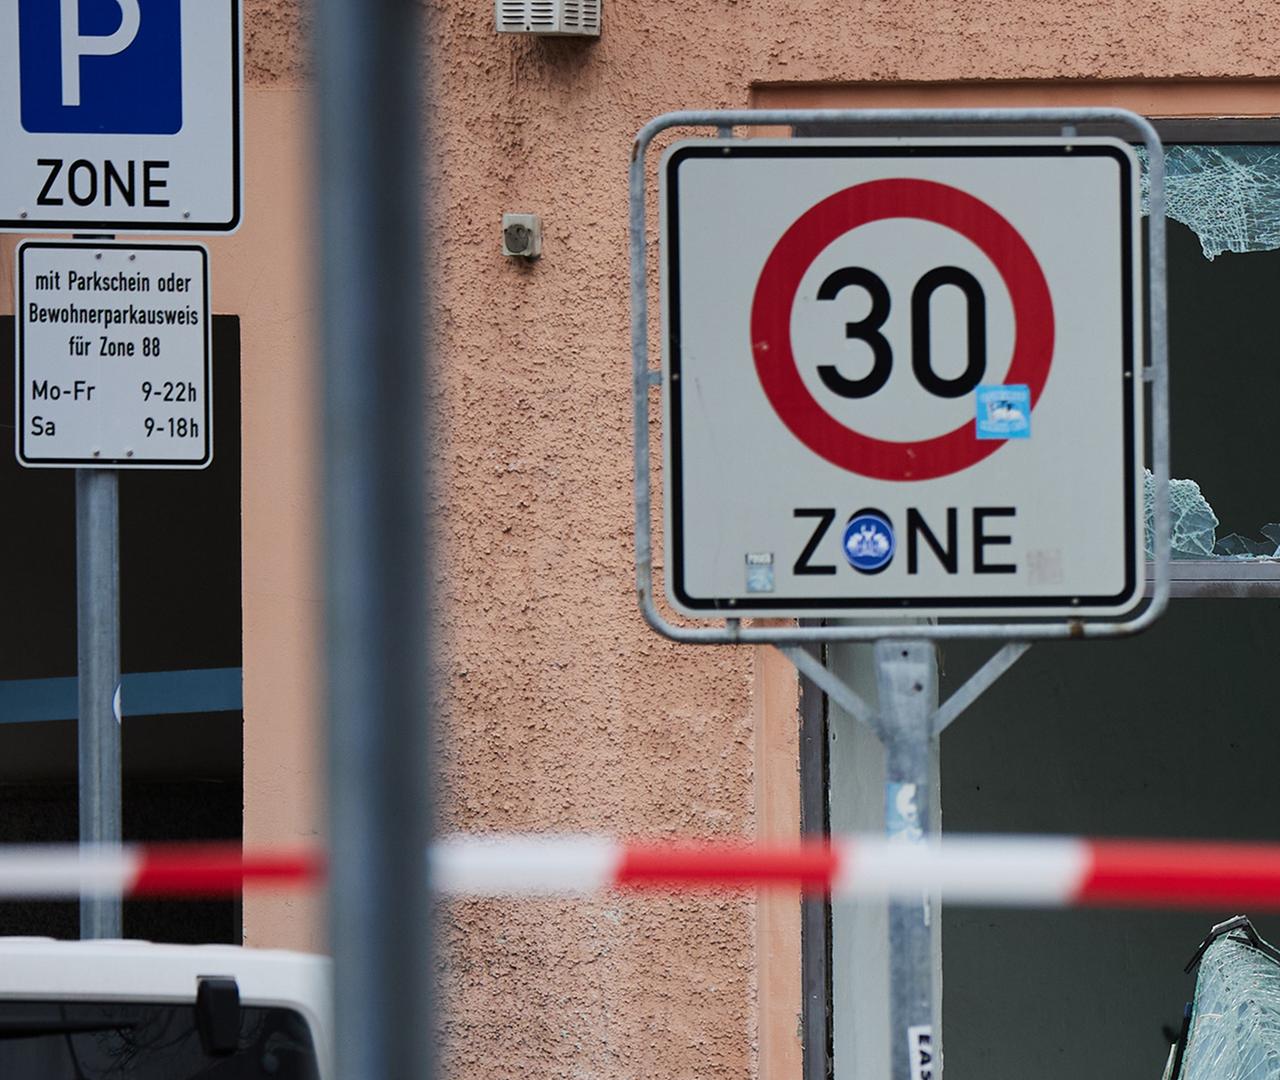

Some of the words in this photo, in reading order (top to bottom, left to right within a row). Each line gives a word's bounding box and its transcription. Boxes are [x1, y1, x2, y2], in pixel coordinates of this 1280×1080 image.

[36, 158, 171, 208] ZONE
[35, 271, 61, 291] mit
[68, 271, 150, 293] Parkschein
[157, 273, 192, 293] oder
[29, 303, 199, 327] Bewohnerparkausweis
[816, 265, 987, 399] 30
[69, 336, 91, 356] für
[99, 337, 135, 357] Zone
[142, 337, 161, 357] 88
[31, 380, 96, 401] Mo-Fr
[141, 382, 197, 402] 9-22h
[31, 415, 56, 437] Sa
[144, 416, 199, 438] 9-18h
